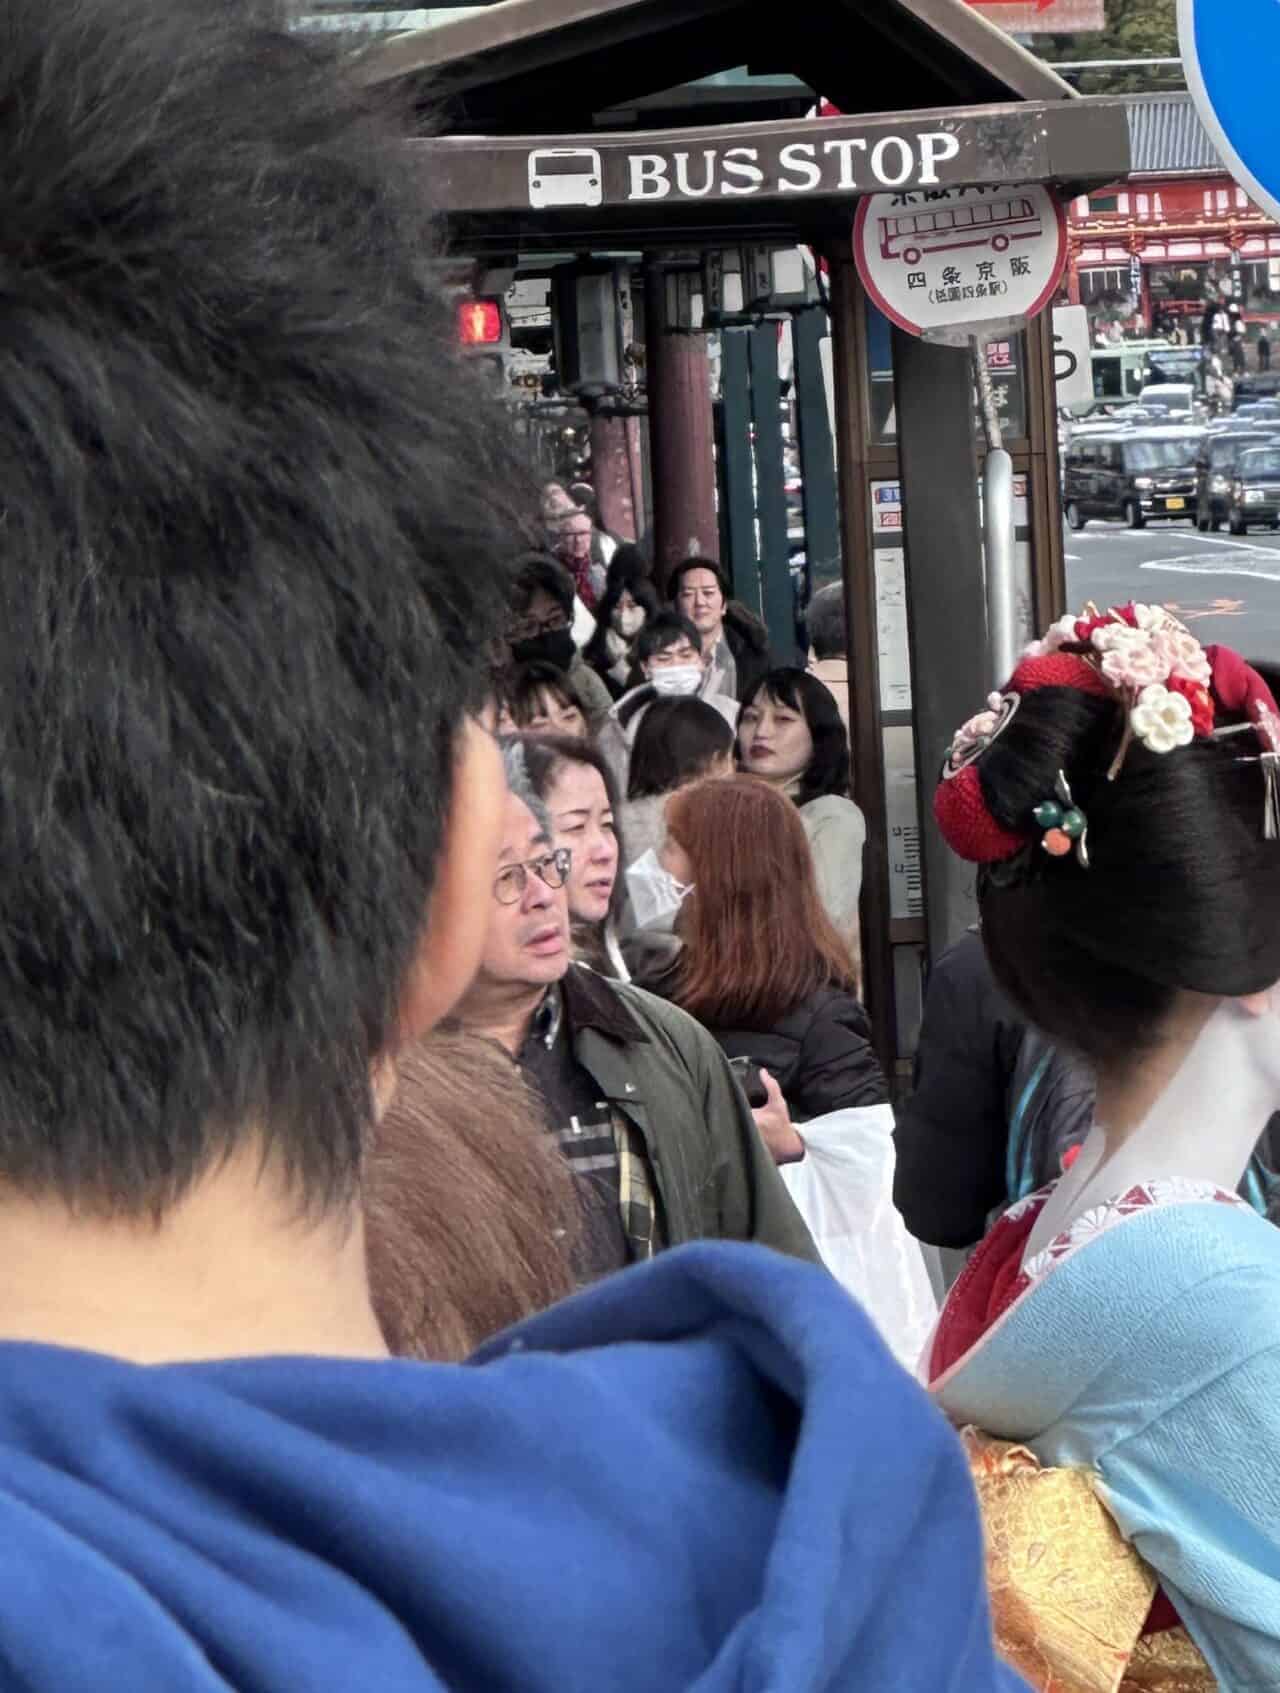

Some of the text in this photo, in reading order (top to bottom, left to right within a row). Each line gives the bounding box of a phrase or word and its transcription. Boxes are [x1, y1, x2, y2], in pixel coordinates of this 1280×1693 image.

[627, 131, 961, 201] BUS STOP
[906, 256, 1032, 290] 四条京阪
